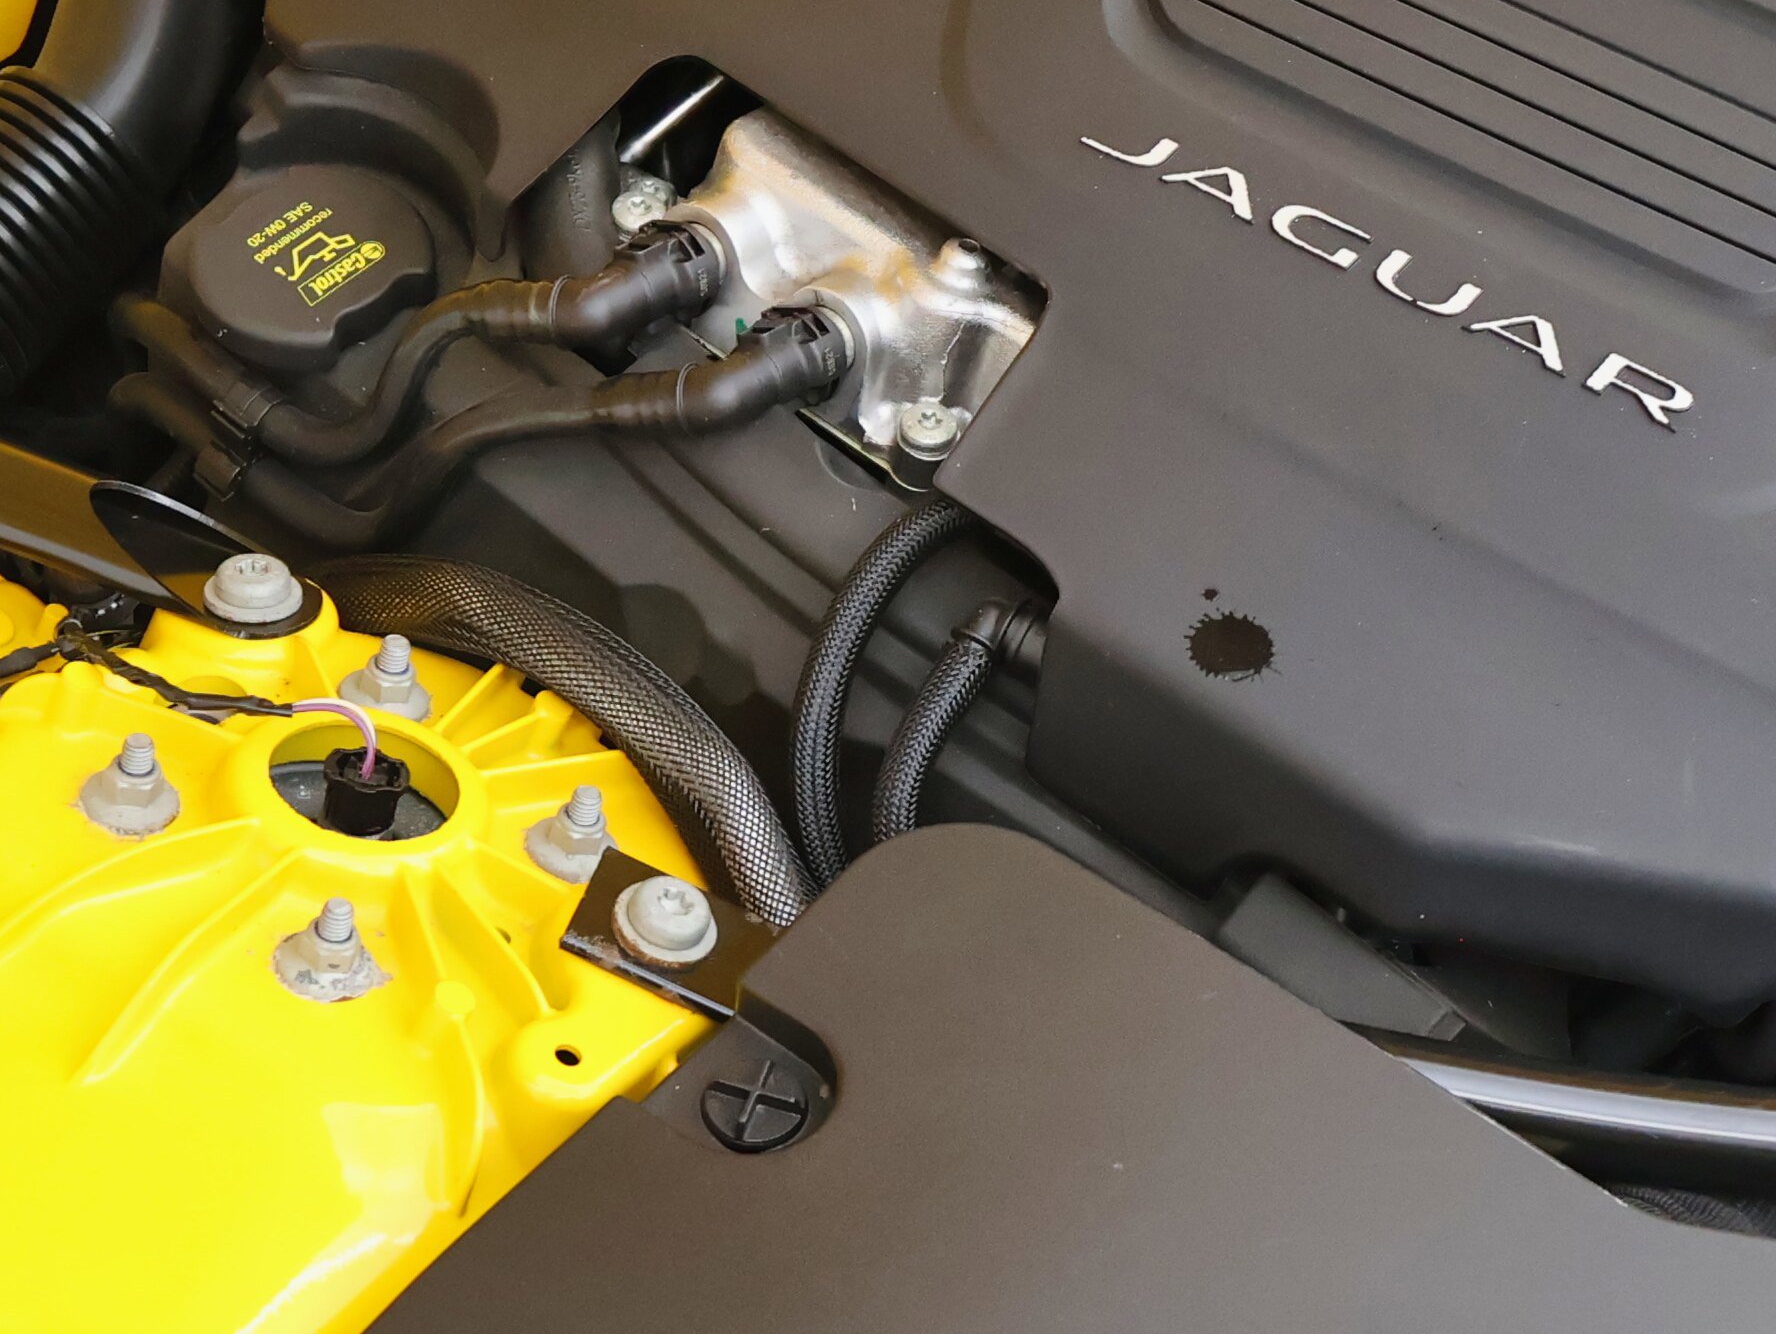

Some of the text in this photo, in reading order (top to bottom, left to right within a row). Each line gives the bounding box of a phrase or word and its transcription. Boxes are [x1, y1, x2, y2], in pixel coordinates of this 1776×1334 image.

[246, 201, 314, 248] SAE 0W-20
[253, 207, 334, 265] recommended
[307, 252, 366, 297] Castrol
[1079, 135, 1695, 433] JAGUAR
